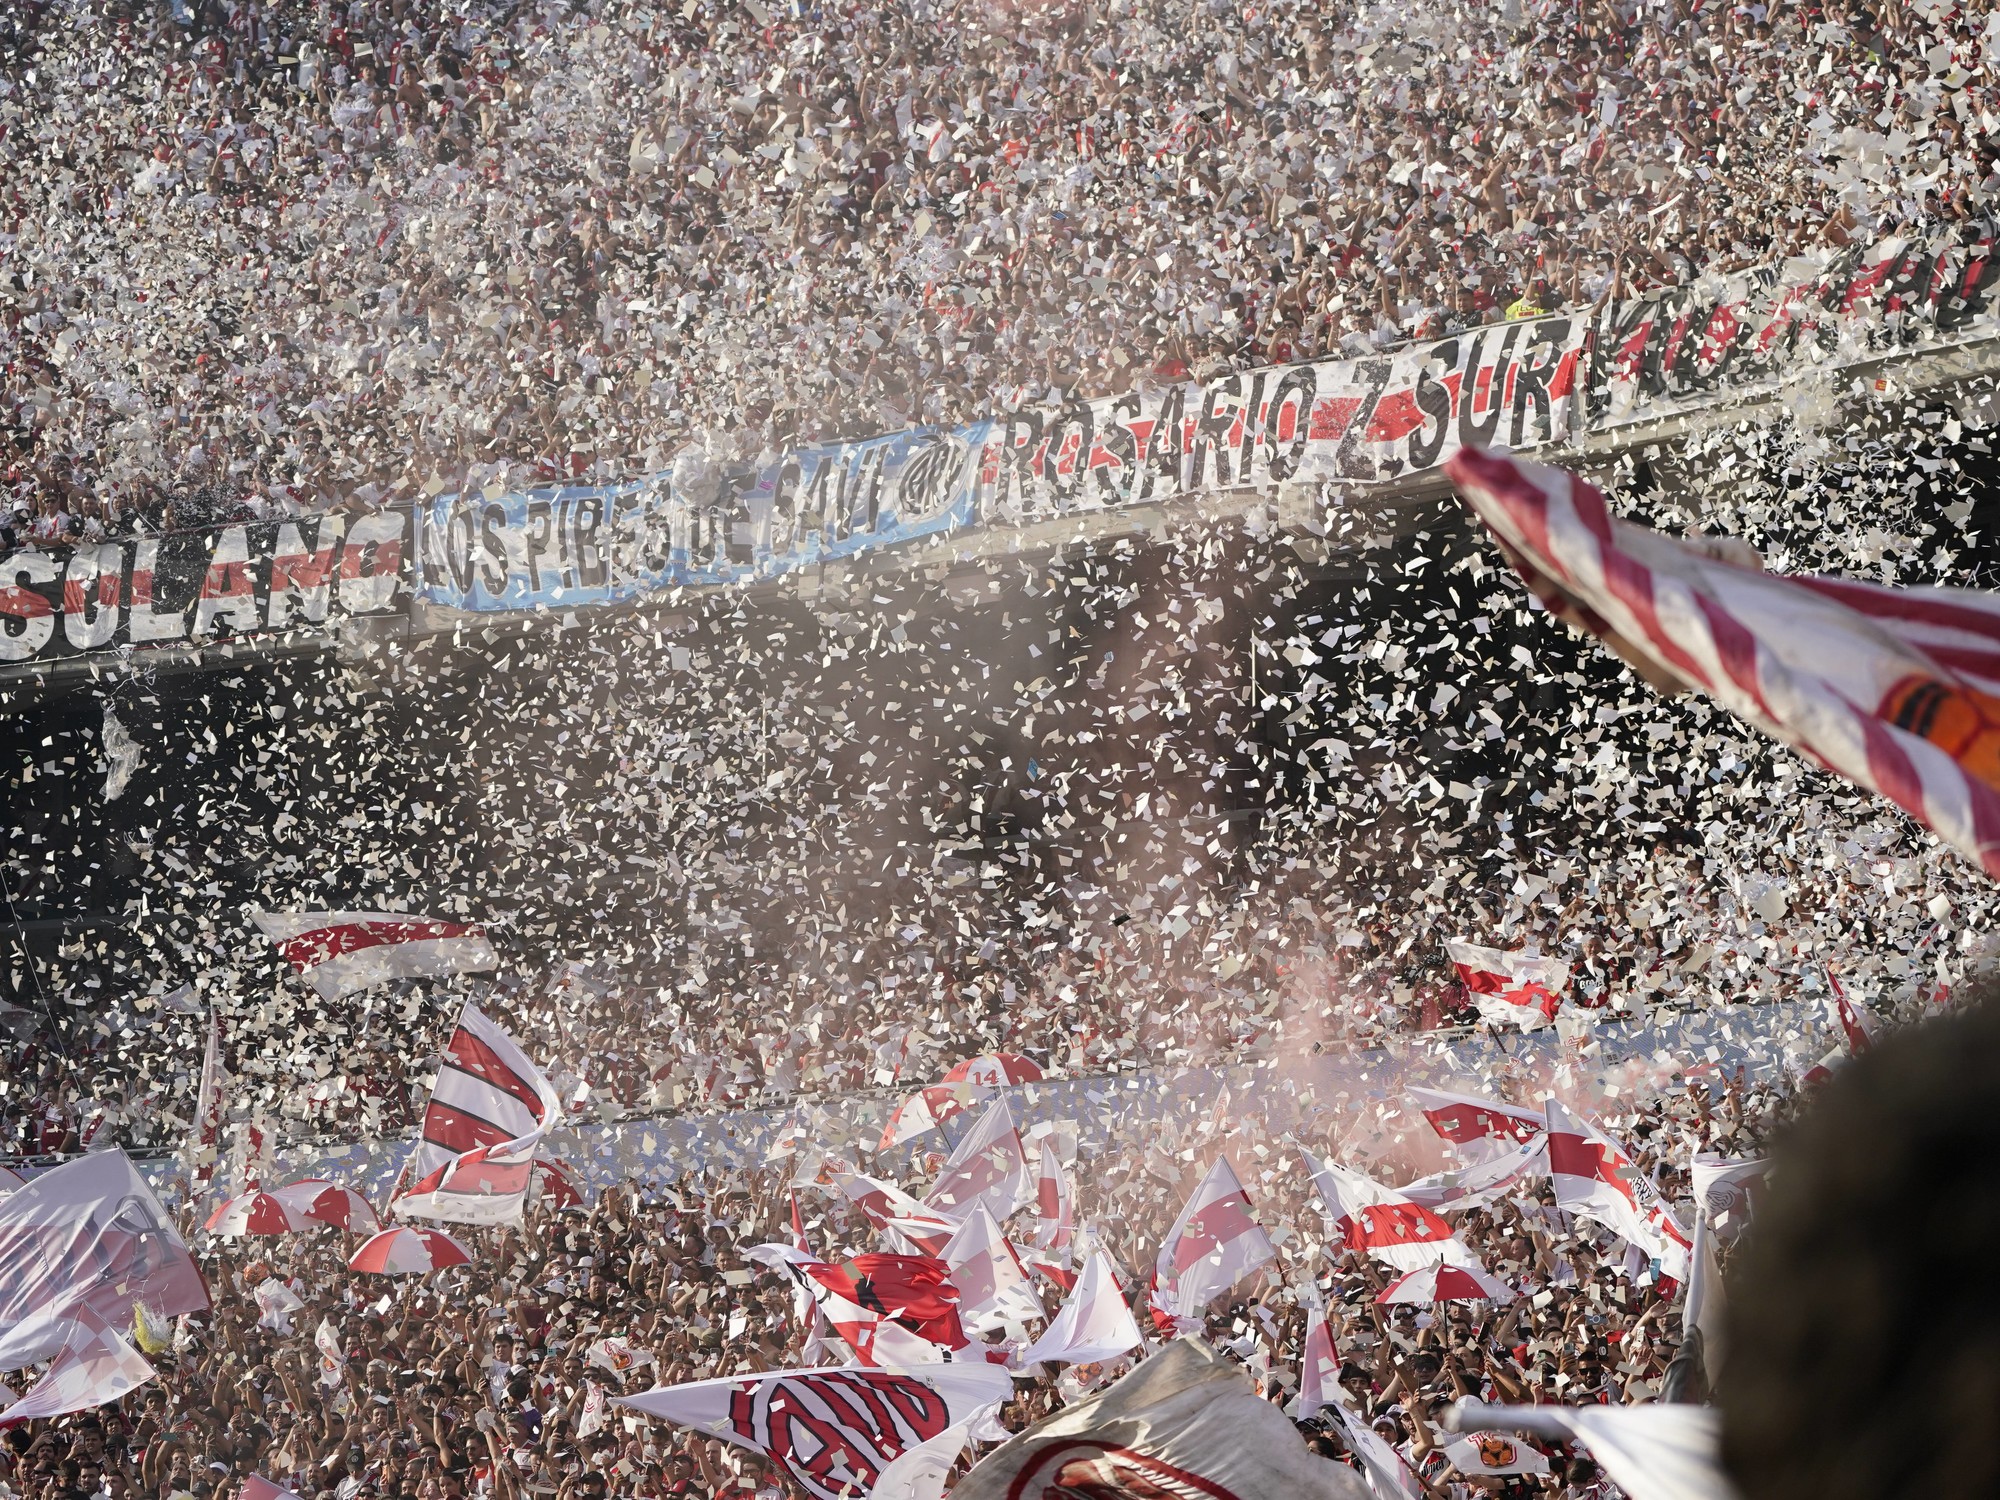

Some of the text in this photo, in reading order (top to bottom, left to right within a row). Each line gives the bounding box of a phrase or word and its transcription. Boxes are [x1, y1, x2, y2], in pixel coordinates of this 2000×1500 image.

[994, 365, 1317, 512] ROSARIO
[1409, 315, 1572, 469] SUR
[0, 510, 406, 661] SOLANO
[421, 498, 509, 597] LOS
[973, 1069, 998, 1086] 14
